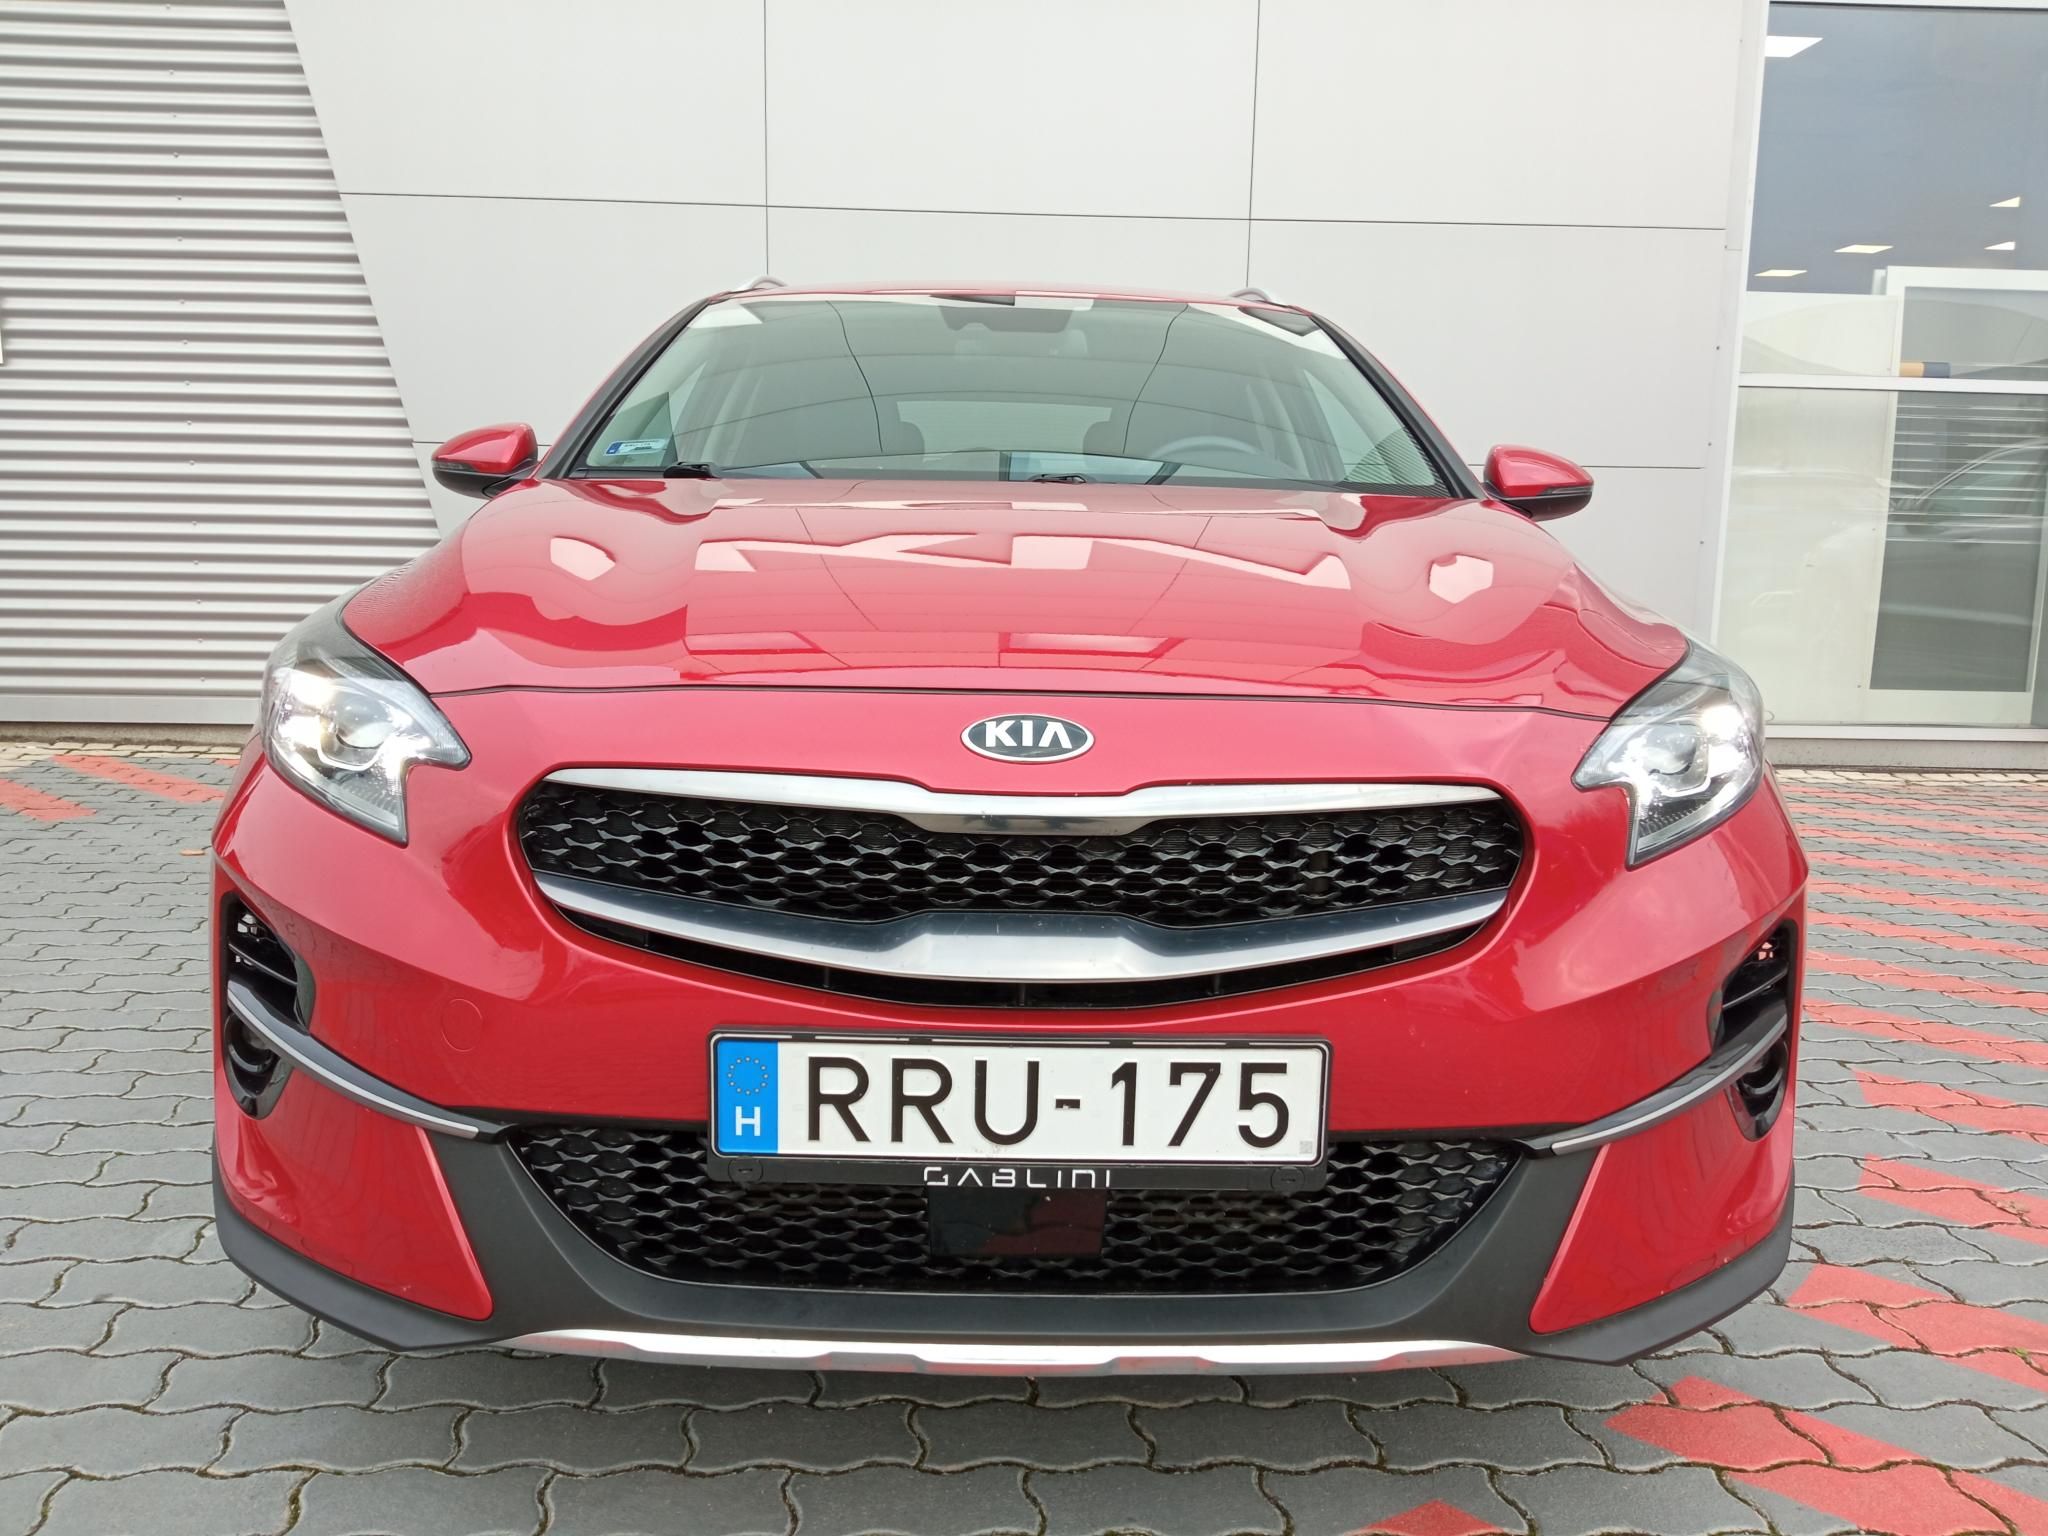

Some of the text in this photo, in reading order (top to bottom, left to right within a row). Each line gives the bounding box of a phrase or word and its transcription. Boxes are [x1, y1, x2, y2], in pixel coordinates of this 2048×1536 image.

[984, 719, 1073, 749] KIA
[808, 1056, 1290, 1149] RRU-175
[735, 1106, 761, 1137] H
[924, 1166, 1111, 1189] GABLINI
